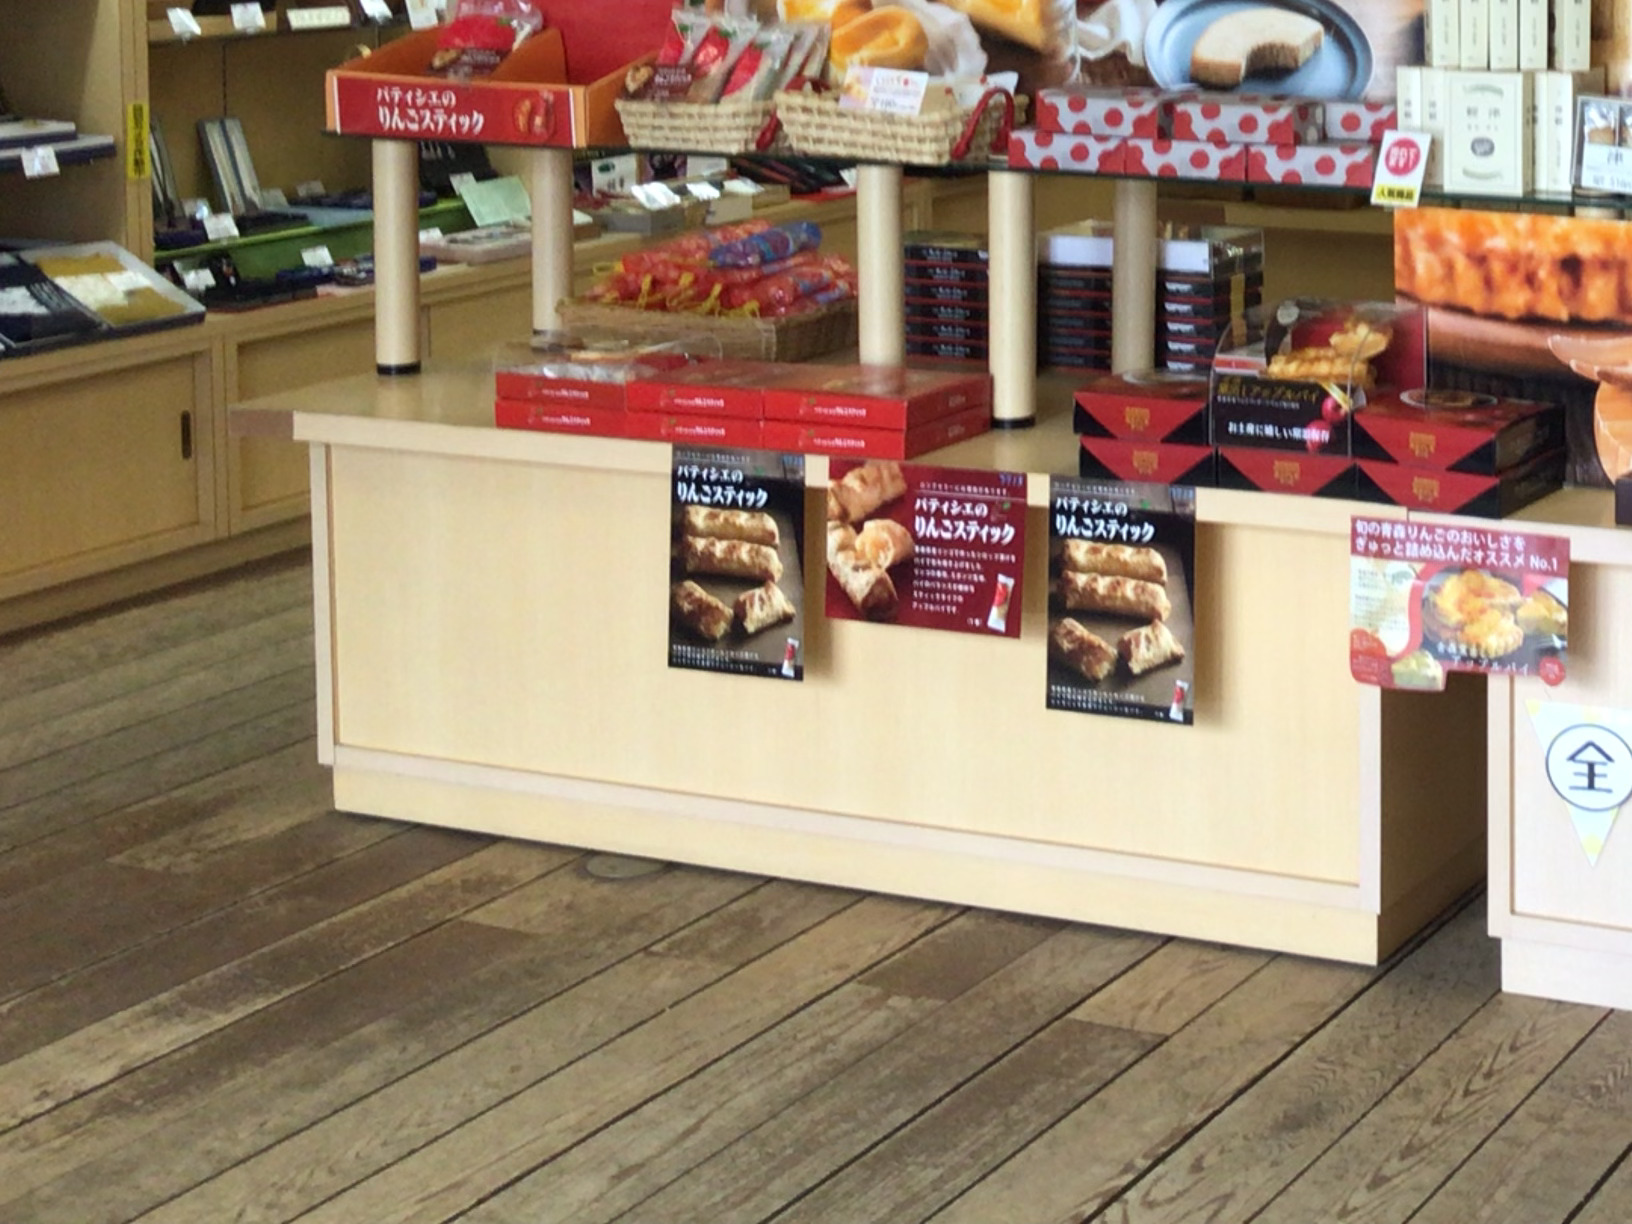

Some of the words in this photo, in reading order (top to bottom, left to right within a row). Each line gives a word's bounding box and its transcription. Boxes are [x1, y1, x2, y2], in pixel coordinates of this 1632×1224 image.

[376, 87, 456, 108] パティシエの
[677, 465, 744, 483] パティシエの
[677, 481, 769, 508] りんごスティック
[914, 497, 989, 518] パティシエの
[1055, 496, 1129, 518] パティシエの
[914, 514, 1016, 546] りんごスティック
[1055, 514, 1156, 544] りんごスティック
[1355, 520, 1526, 551] 旬の青森りんごのおいしさを
[1355, 538, 1526, 568] ぎゅっと詰め込んだオススメ
[1530, 556, 1559, 572] No.1
